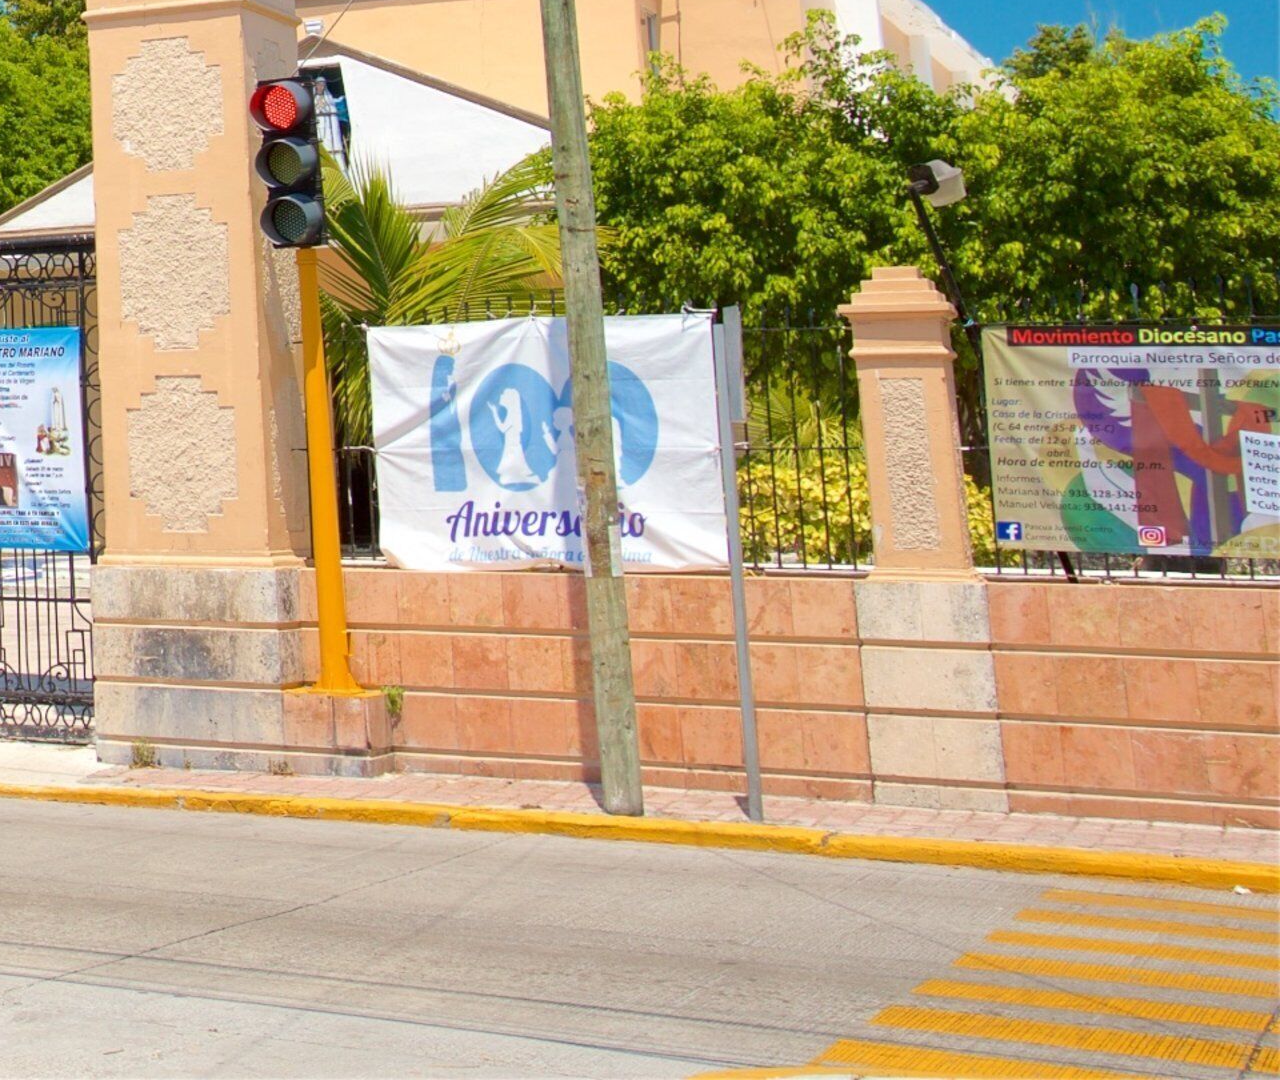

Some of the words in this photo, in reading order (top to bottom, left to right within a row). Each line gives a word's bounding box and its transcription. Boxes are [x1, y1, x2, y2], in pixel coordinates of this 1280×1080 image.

[1012, 328, 1134, 344] Movimiento
[19, 346, 65, 357] MARIANO
[1072, 352, 1141, 366] Parroquia
[1146, 352, 1204, 364] Nuestra
[1209, 352, 1261, 364] Señora
[994, 378, 1002, 386] Si
[1005, 378, 1035, 386] tienes
[1038, 379, 1065, 387] entre
[1100, 377, 1126, 387] años
[1159, 379, 1166, 387] Y
[1168, 379, 1193, 387] VIVE
[1196, 379, 1221, 388] ESTA
[991, 397, 1022, 407] Lugar:
[992, 410, 1015, 419] Casa
[1018, 410, 1030, 418] de
[1033, 409, 1042, 419] la
[1009, 422, 1021, 431] 64
[1024, 423, 1050, 432] entre
[1079, 425, 1086, 434] y
[994, 435, 1025, 445] Fecha:
[1028, 436, 1044, 445] del
[1047, 436, 1059, 445] 12
[1061, 437, 1071, 445] al
[1075, 437, 1087, 446] 15
[1089, 437, 1102, 446] de
[1245, 436, 1260, 446] No
[997, 457, 1027, 467] Hora
[1030, 457, 1044, 467] de
[1049, 458, 1103, 470] entrada:
[1106, 460, 1134, 469] 5:00
[1137, 461, 1165, 471] p.m.
[997, 474, 1044, 483] Informes:
[1249, 476, 1277, 486] entre
[998, 487, 1040, 496] Mariana
[999, 499, 1037, 509] Manuel
[446, 500, 647, 543] Aniversio
